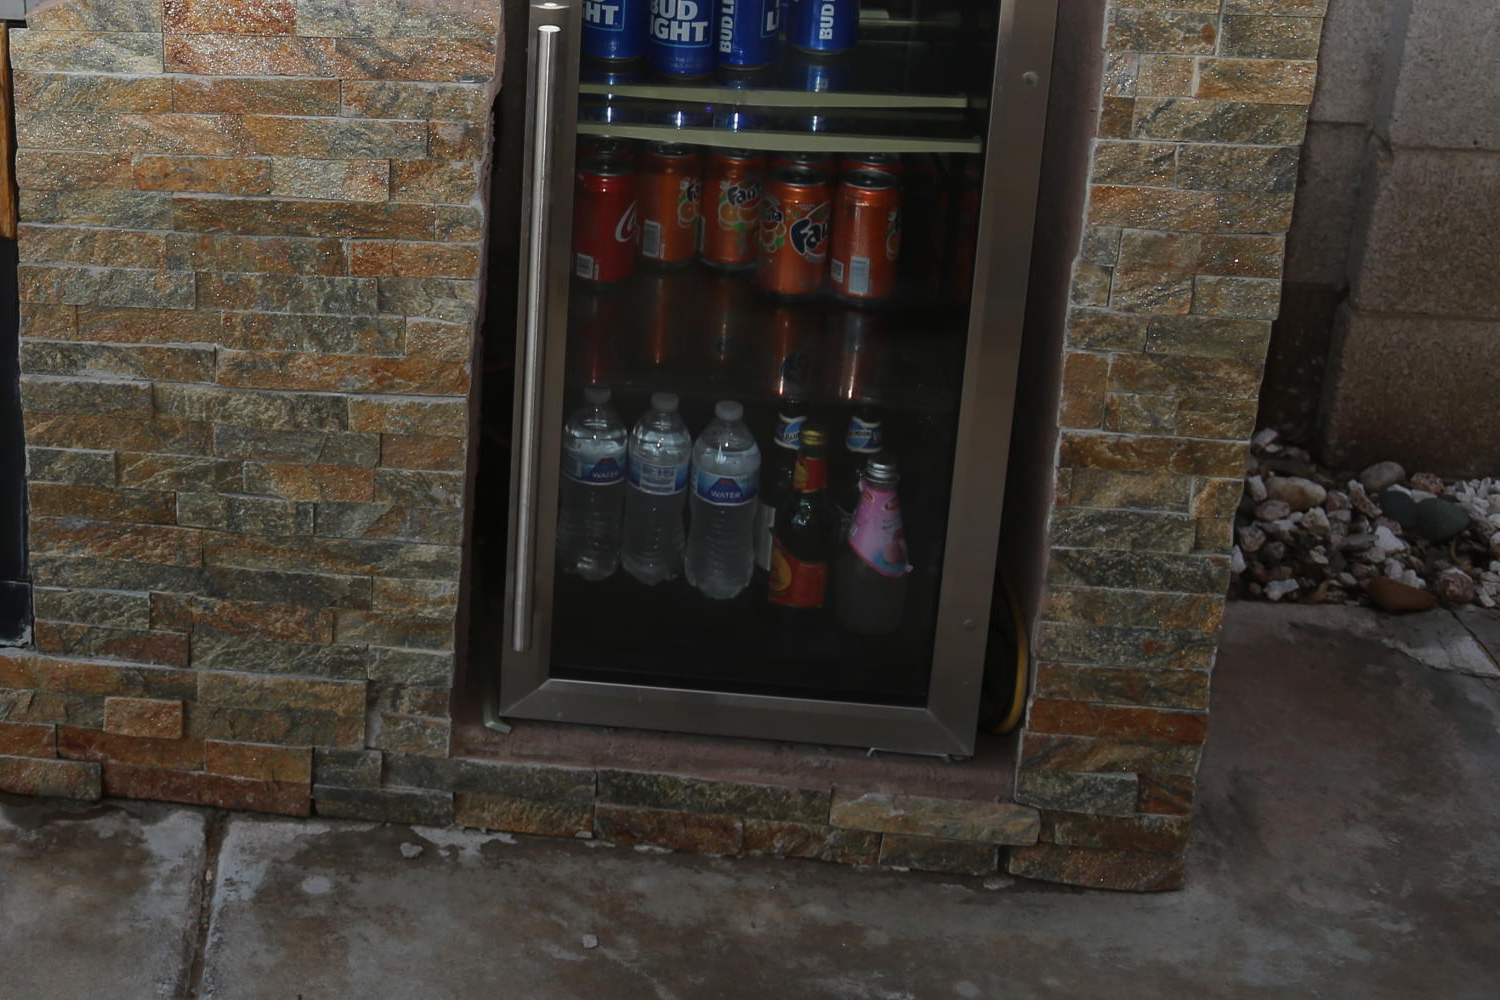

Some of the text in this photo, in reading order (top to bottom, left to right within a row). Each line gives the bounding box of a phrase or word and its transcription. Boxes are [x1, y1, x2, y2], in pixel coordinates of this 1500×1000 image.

[719, 16, 734, 54] BUD
[819, 3, 836, 41] BUD
[710, 489, 741, 502] WATER
